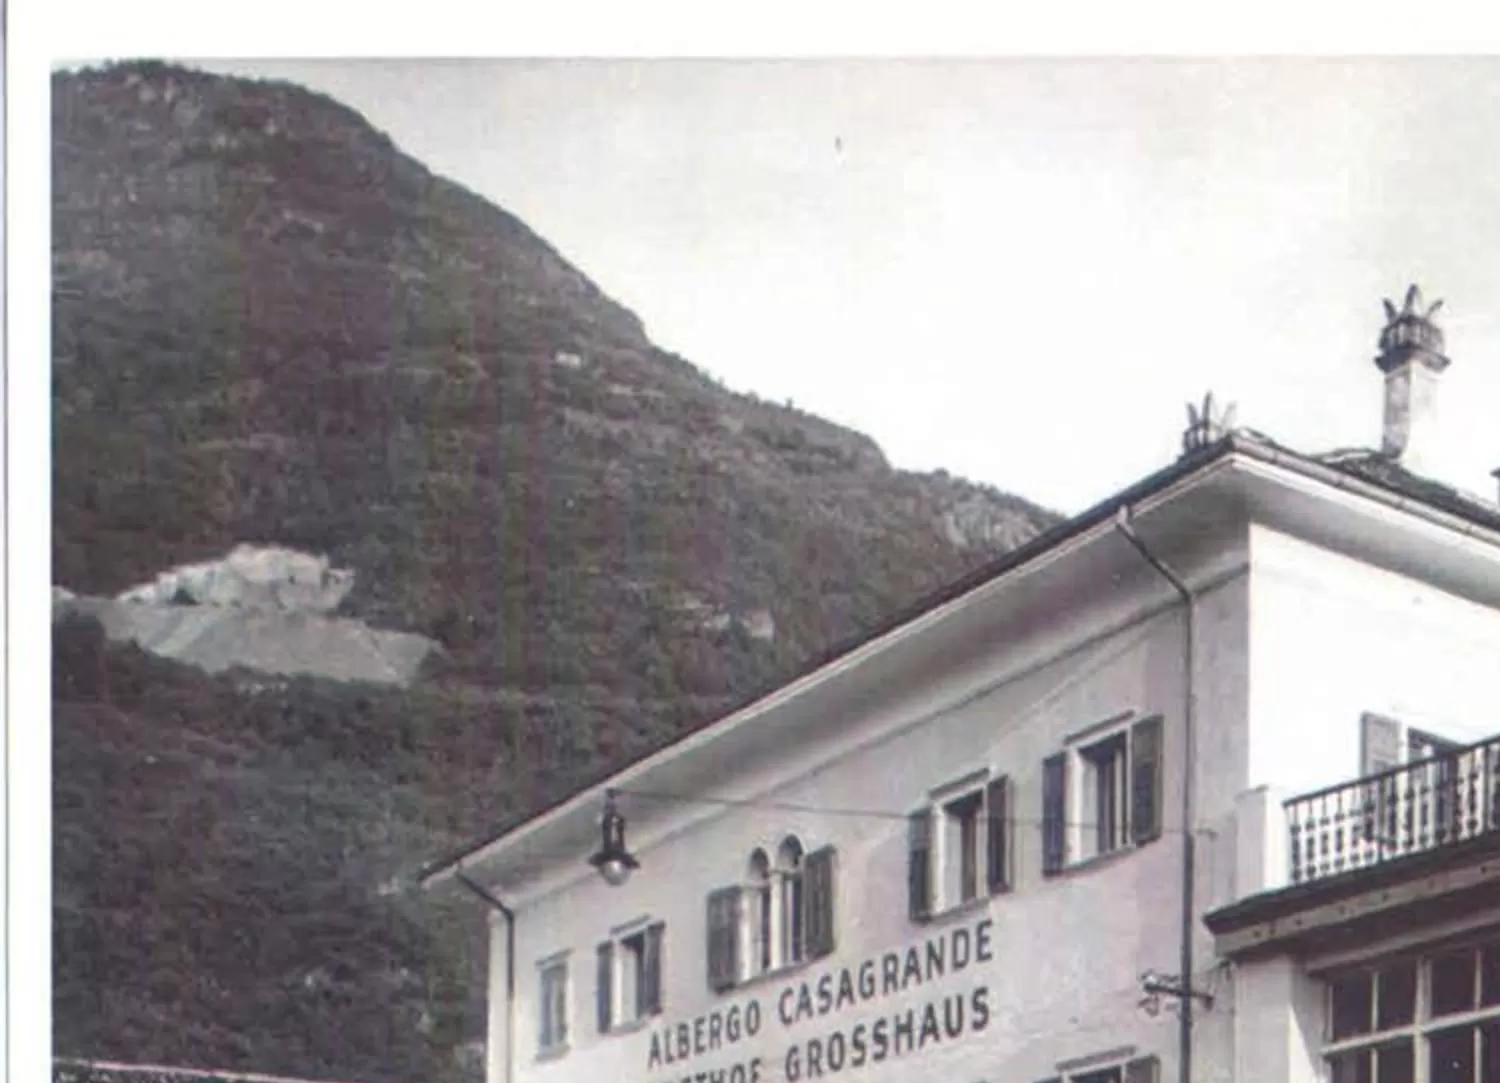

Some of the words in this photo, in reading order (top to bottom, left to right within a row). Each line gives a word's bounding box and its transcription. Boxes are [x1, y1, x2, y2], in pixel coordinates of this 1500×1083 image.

[647, 999, 761, 1069] ALBERGO
[778, 919, 994, 1024] CASAGRANDE
[785, 987, 991, 1079] GROSSHAUS
